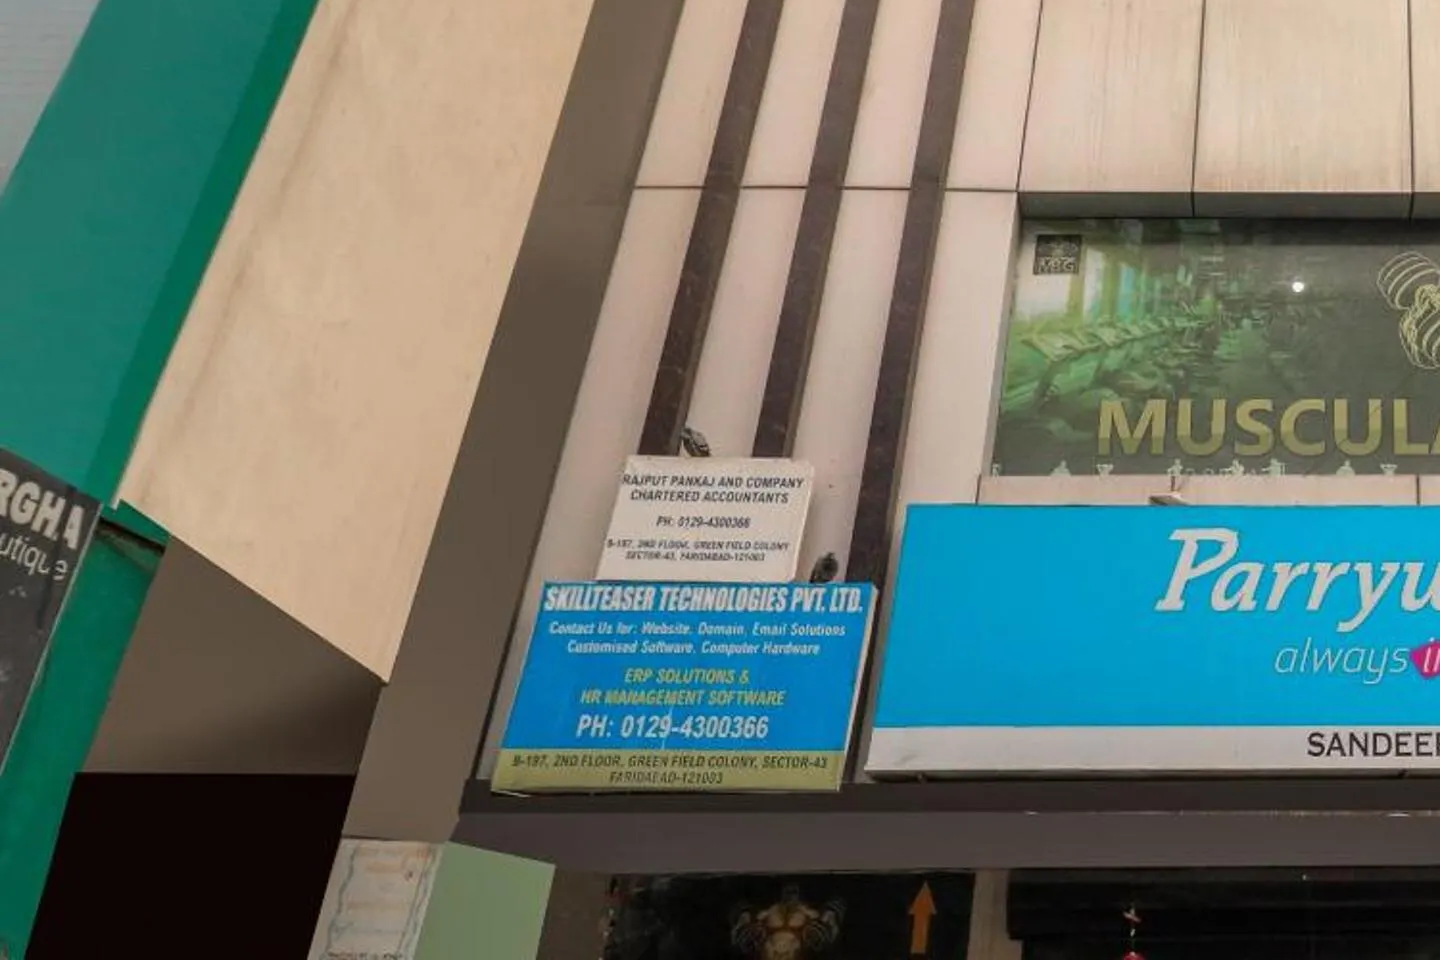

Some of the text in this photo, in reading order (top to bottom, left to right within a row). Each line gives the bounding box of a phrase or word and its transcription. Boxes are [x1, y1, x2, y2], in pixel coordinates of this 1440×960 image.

[622, 474, 805, 489] RAJPUT PANKAJ AND COMPANY
[630, 490, 789, 504] CHARTERED ACCOUNTANTS
[543, 586, 864, 613] SKILLTEASER TECHNOLOGIES PVT. LTD.
[550, 621, 596, 635] Contact
[598, 621, 614, 635] Us
[751, 622, 788, 636] Email
[790, 622, 846, 637] Solutions
[567, 639, 638, 654] Customised
[701, 641, 760, 656] Computer
[761, 642, 821, 655] Hardware
[1274, 637, 1410, 685] always
[624, 668, 750, 685] ERP SOLUTIONS &
[581, 689, 787, 706] HR MANAGEMENT SOFTWARE
[575, 714, 770, 739] PH: 0129-4300366
[552, 755, 579, 767] 2ND
[627, 755, 667, 768] GREEN
[671, 756, 706, 768] FIELD
[761, 756, 828, 769] SECTOR-43
